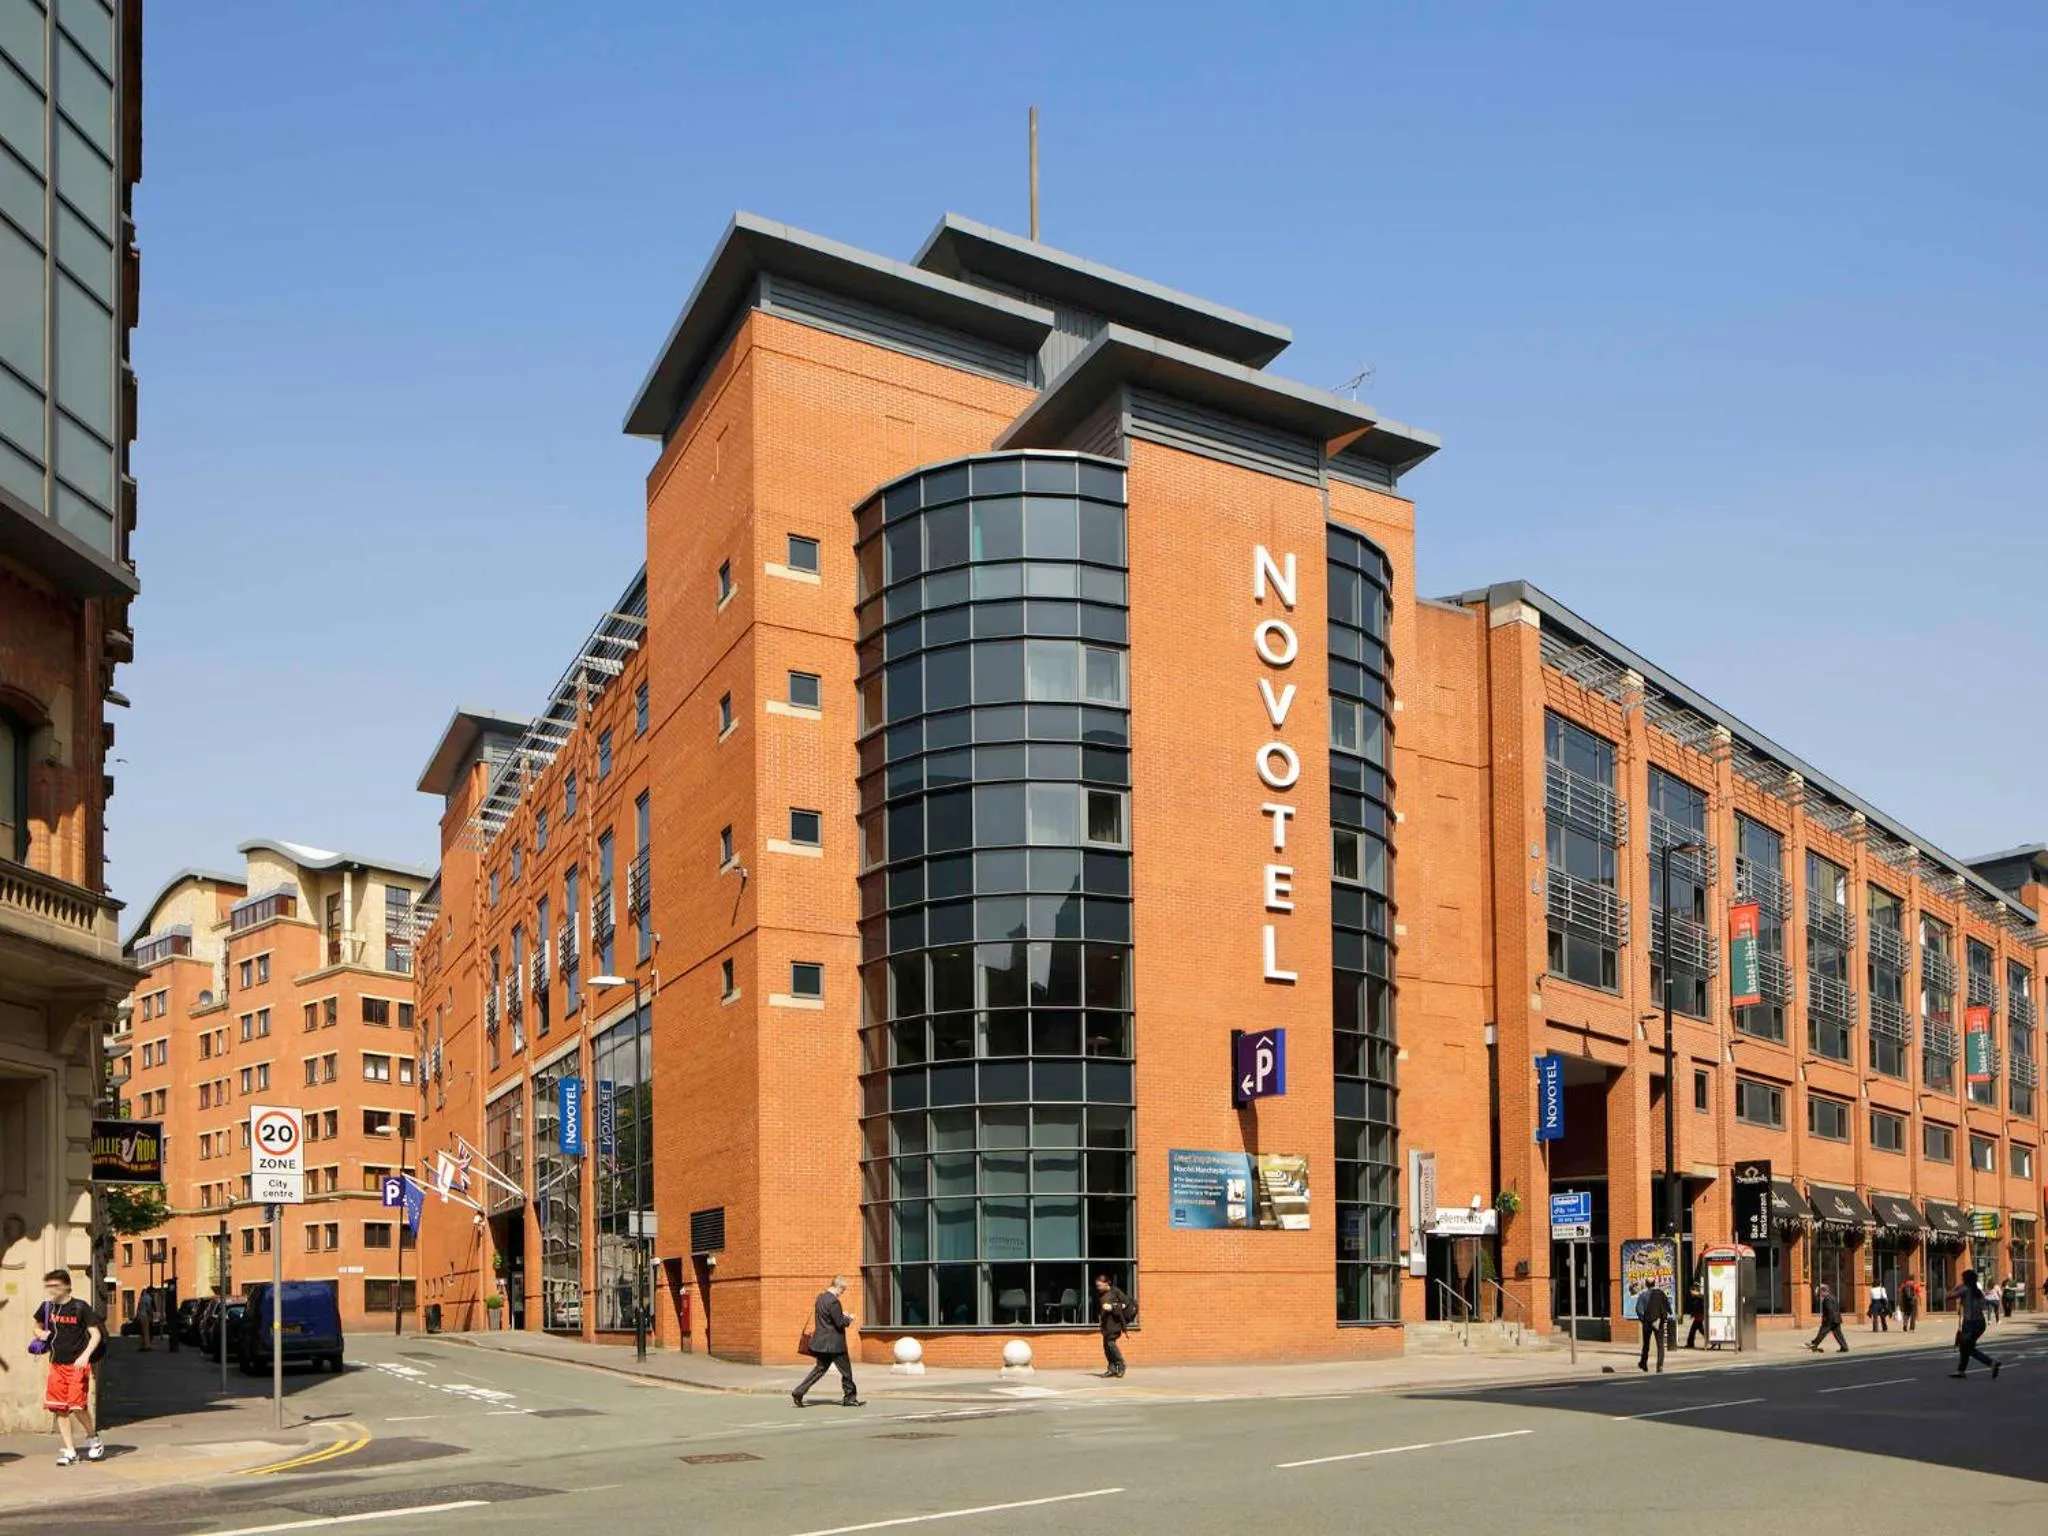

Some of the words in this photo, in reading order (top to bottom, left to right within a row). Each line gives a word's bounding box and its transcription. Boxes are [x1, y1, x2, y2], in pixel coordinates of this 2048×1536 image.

[1253, 545, 1300, 983] NOVOTEL
[1256, 1048, 1274, 1093] P
[1546, 1060, 1558, 1129] NOVOTEL
[565, 1083, 577, 1144] NOVOTEL
[262, 1124, 293, 1142] 20
[259, 1158, 297, 1170] ZONE
[262, 1190, 294, 1198] centre
[268, 1179, 288, 1190] City
[385, 1184, 400, 1206] P
[1438, 1212, 1482, 1225] elements
[1759, 1191, 1768, 1239] Restaurant
[1750, 1223, 1759, 1239] Bar
